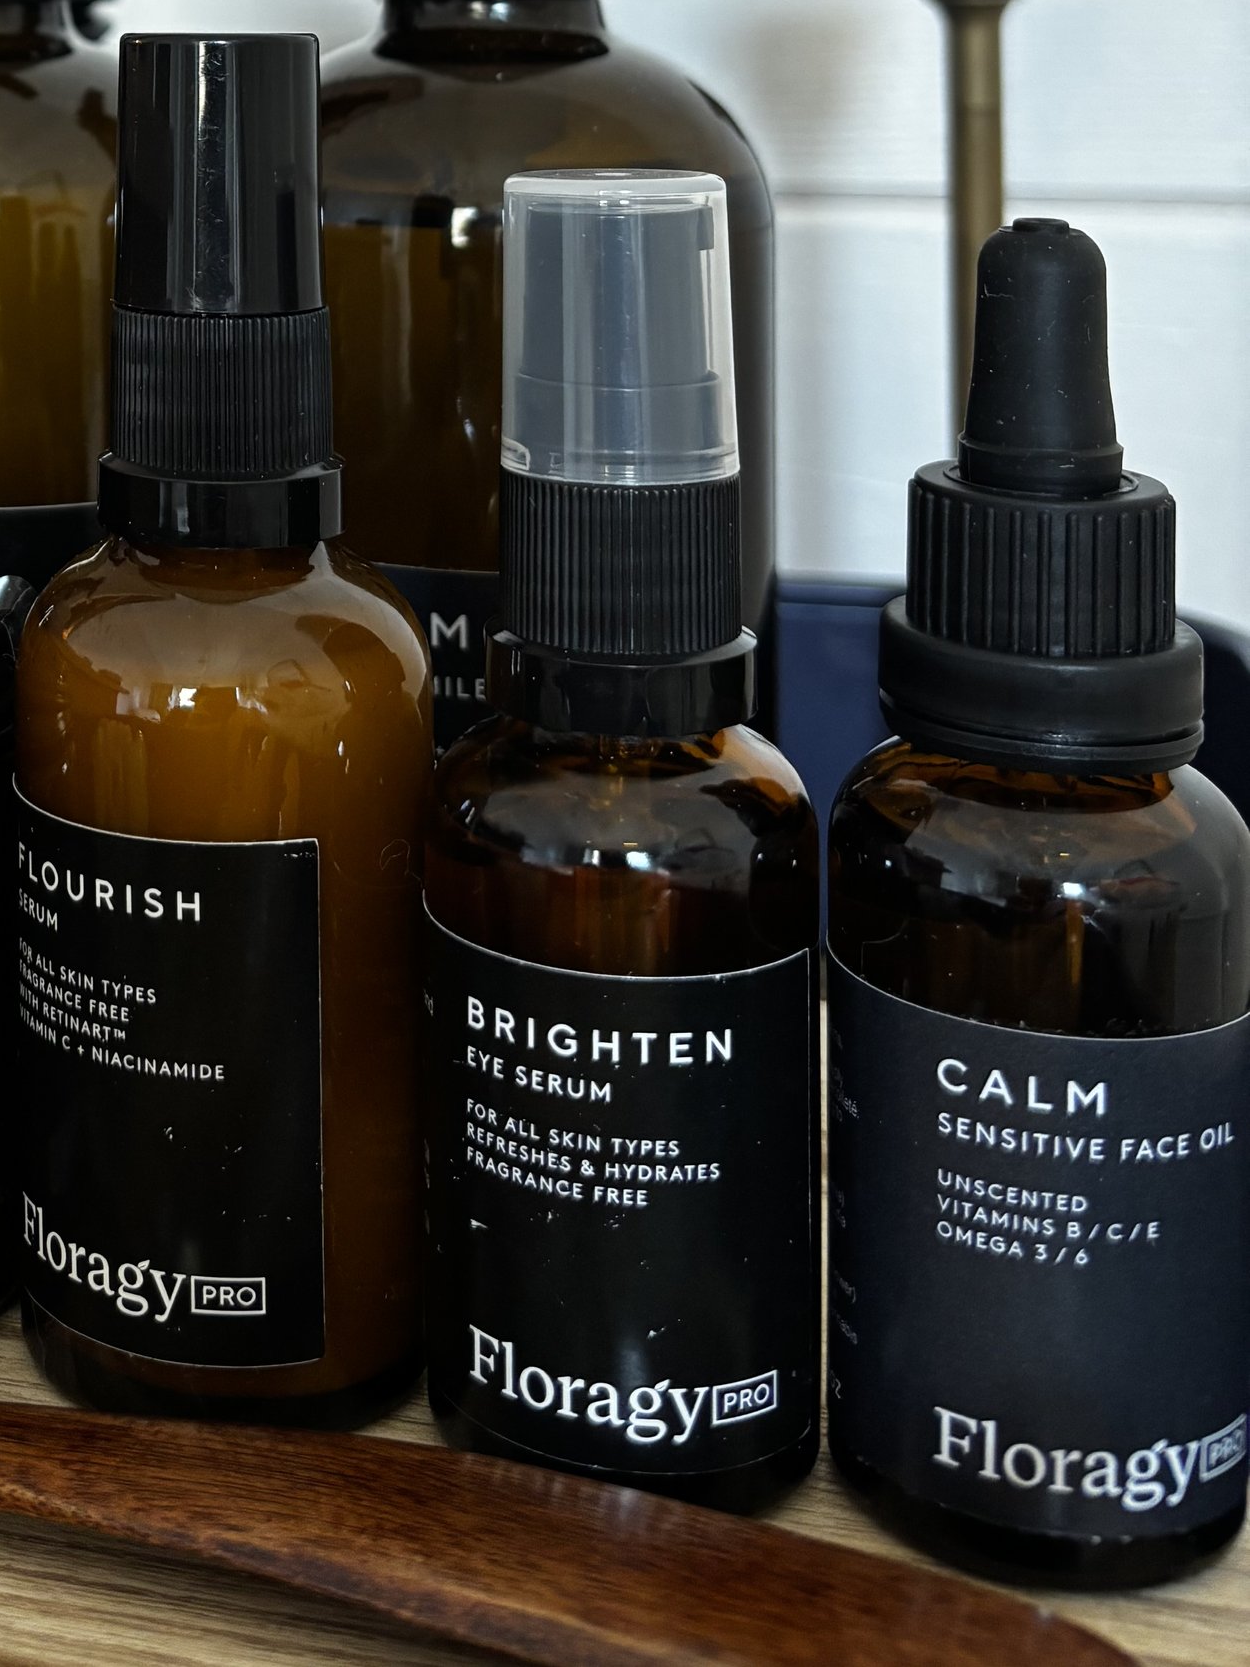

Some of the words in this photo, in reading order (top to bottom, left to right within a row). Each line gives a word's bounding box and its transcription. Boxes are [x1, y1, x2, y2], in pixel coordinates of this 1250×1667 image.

[19, 841, 201, 922] FLOURISH
[19, 888, 59, 933] SERUM
[19, 959, 82, 1010] FRAGRANCE
[89, 998, 129, 1022] FREE
[19, 982, 39, 1011] WITH
[35, 953, 55, 976] ALL
[60, 965, 94, 991] SKIN
[101, 979, 157, 1004] TYPES
[19, 1007, 57, 1045] VITAMIN
[61, 1035, 71, 1050] C
[92, 1045, 225, 1081] NIACINAMIDE
[467, 995, 732, 1065] BRIGHTEN
[467, 1045, 504, 1079] EYE
[515, 1065, 611, 1103] SERUM
[937, 1058, 1107, 1117] CALM
[466, 1098, 498, 1126] FOR
[504, 1116, 541, 1140] ALL
[549, 1128, 601, 1152] SKIN
[611, 1137, 680, 1157] TYPES
[467, 1121, 572, 1173] REFRESHES
[580, 1159, 596, 1177] &
[605, 1162, 720, 1182] HYDRATES
[938, 1112, 1105, 1161] SENSITIVE
[1120, 1133, 1190, 1161] FACE
[1199, 1122, 1234, 1151] OIL
[467, 1146, 583, 1200] FRAGRANCE
[594, 1185, 648, 1207] FREE
[937, 1168, 1088, 1213] UNSCENTED
[936, 1220, 1023, 1258] OMEGA
[937, 1193, 1056, 1236] VITAMINS
[22, 1191, 186, 1322] Floragy
[469, 1324, 710, 1444] Floragy
[933, 1406, 1200, 1511] Floragy
